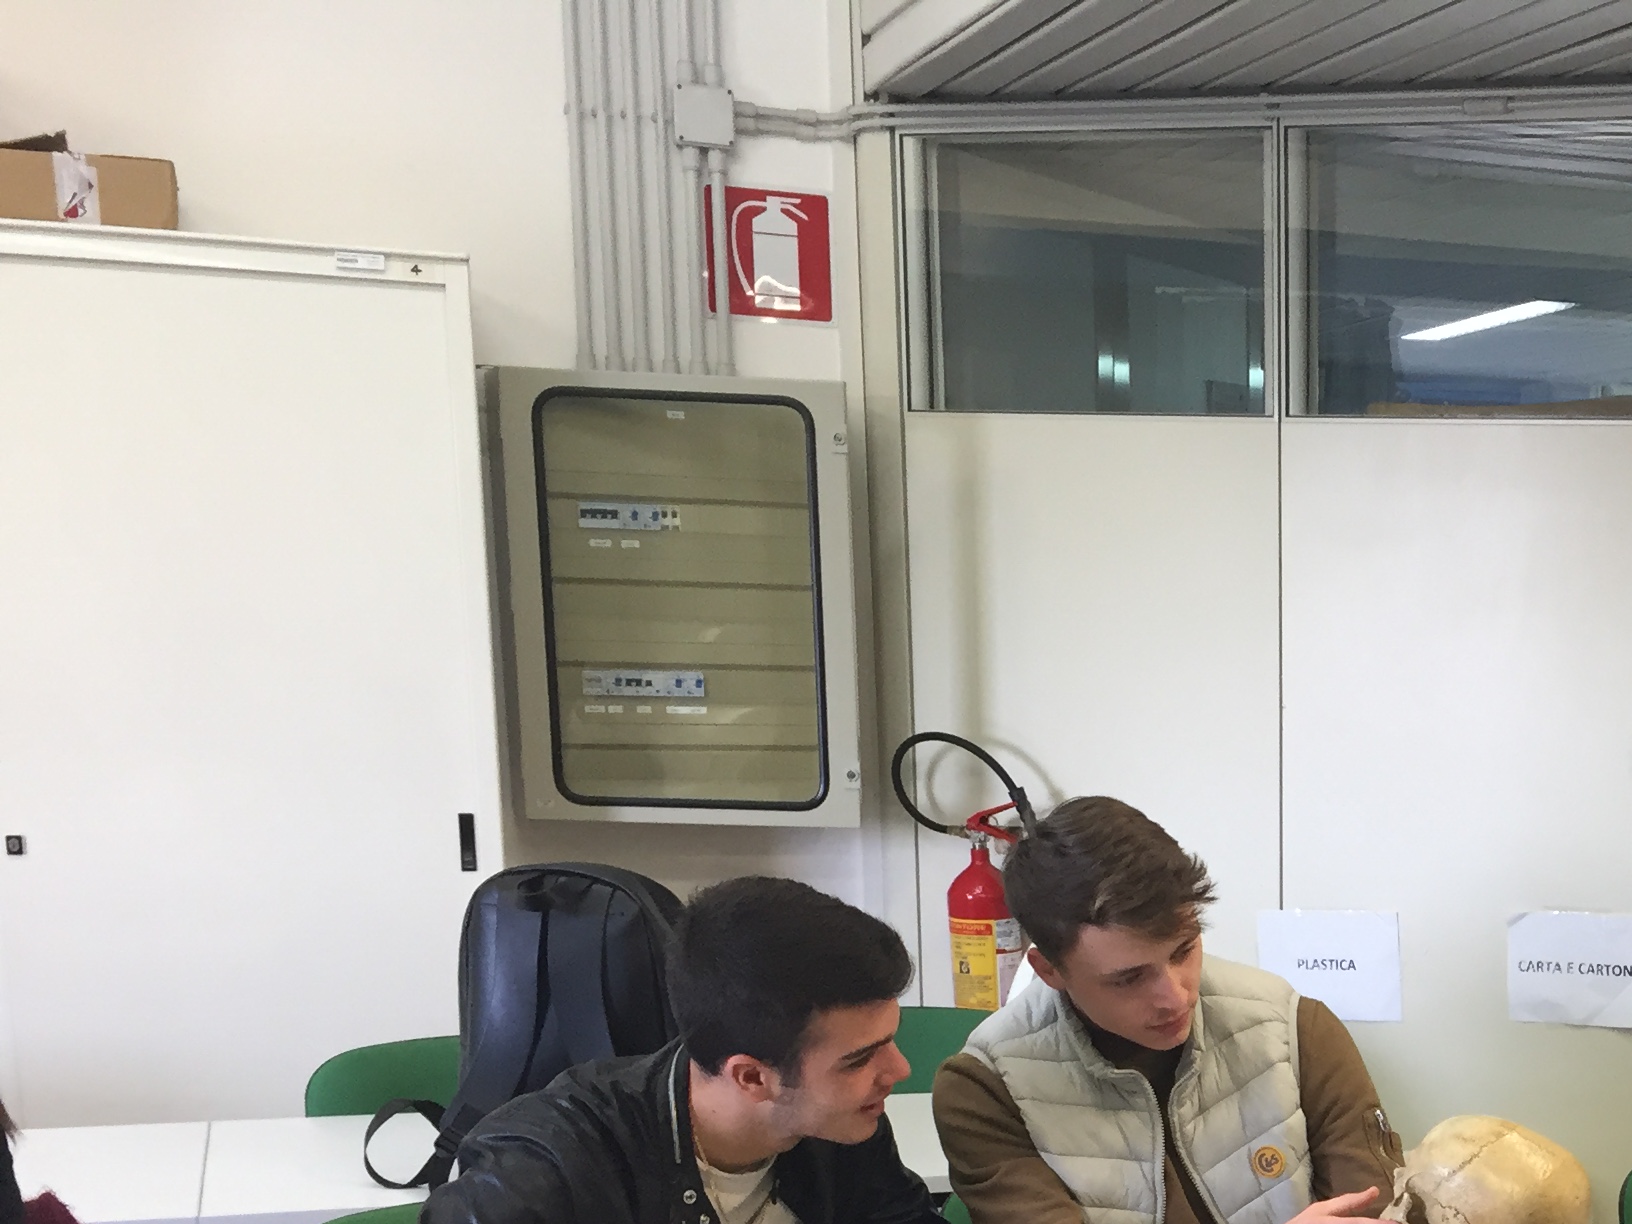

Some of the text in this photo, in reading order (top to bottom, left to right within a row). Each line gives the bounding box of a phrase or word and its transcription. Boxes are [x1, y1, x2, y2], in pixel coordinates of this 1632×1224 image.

[410, 264, 422, 276] 4
[1297, 958, 1357, 971] PLASTICA
[1518, 960, 1563, 974] CARTA
[1566, 961, 1575, 974] E
